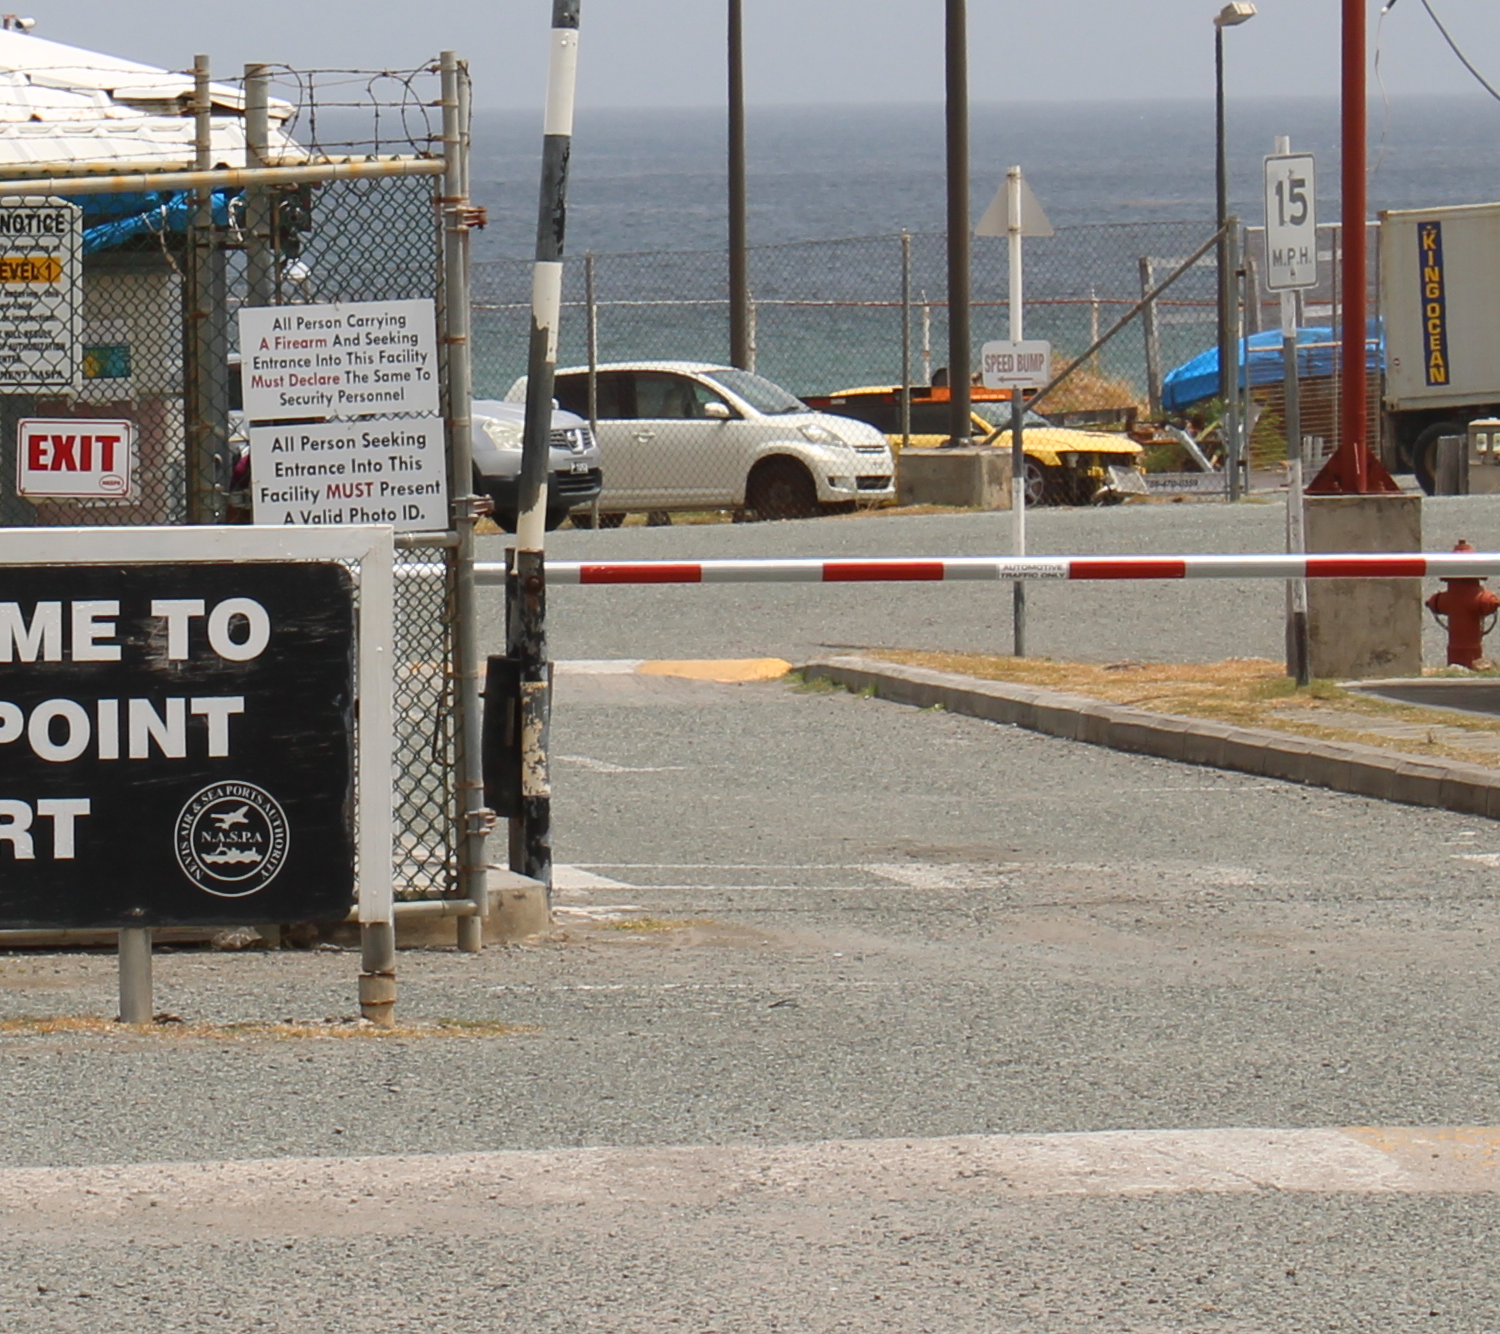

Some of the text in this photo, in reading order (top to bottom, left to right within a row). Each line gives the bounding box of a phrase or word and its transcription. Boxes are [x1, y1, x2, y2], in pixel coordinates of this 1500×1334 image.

[1275, 178, 1308, 226] 15
[0, 214, 65, 233] NOTICE
[1273, 246, 1312, 267] M.P.H.
[45, 263, 52, 280] 1
[1422, 231, 1446, 383] KING OCEAN
[272, 313, 406, 331] All Person Carrying
[260, 331, 418, 350] A Firearm And Seeking
[253, 350, 428, 370] Entrance Into This Facility
[985, 353, 1044, 372] SPEED BUMP
[251, 367, 431, 388] Must Declare The Same To
[280, 387, 405, 407] Security Personnel
[271, 431, 426, 453] All Person Seeking
[28, 434, 121, 472] EXIT
[275, 455, 423, 477] Entrance Into This
[260, 480, 441, 504] Facility MUST Present
[284, 505, 425, 525] A Valid Photo ID.
[151, 597, 271, 661] TO
[180, 785, 284, 880] NEVIS AIR & SEA PORTS AUTHORITY
[201, 831, 262, 843] N.A.S.P.A
